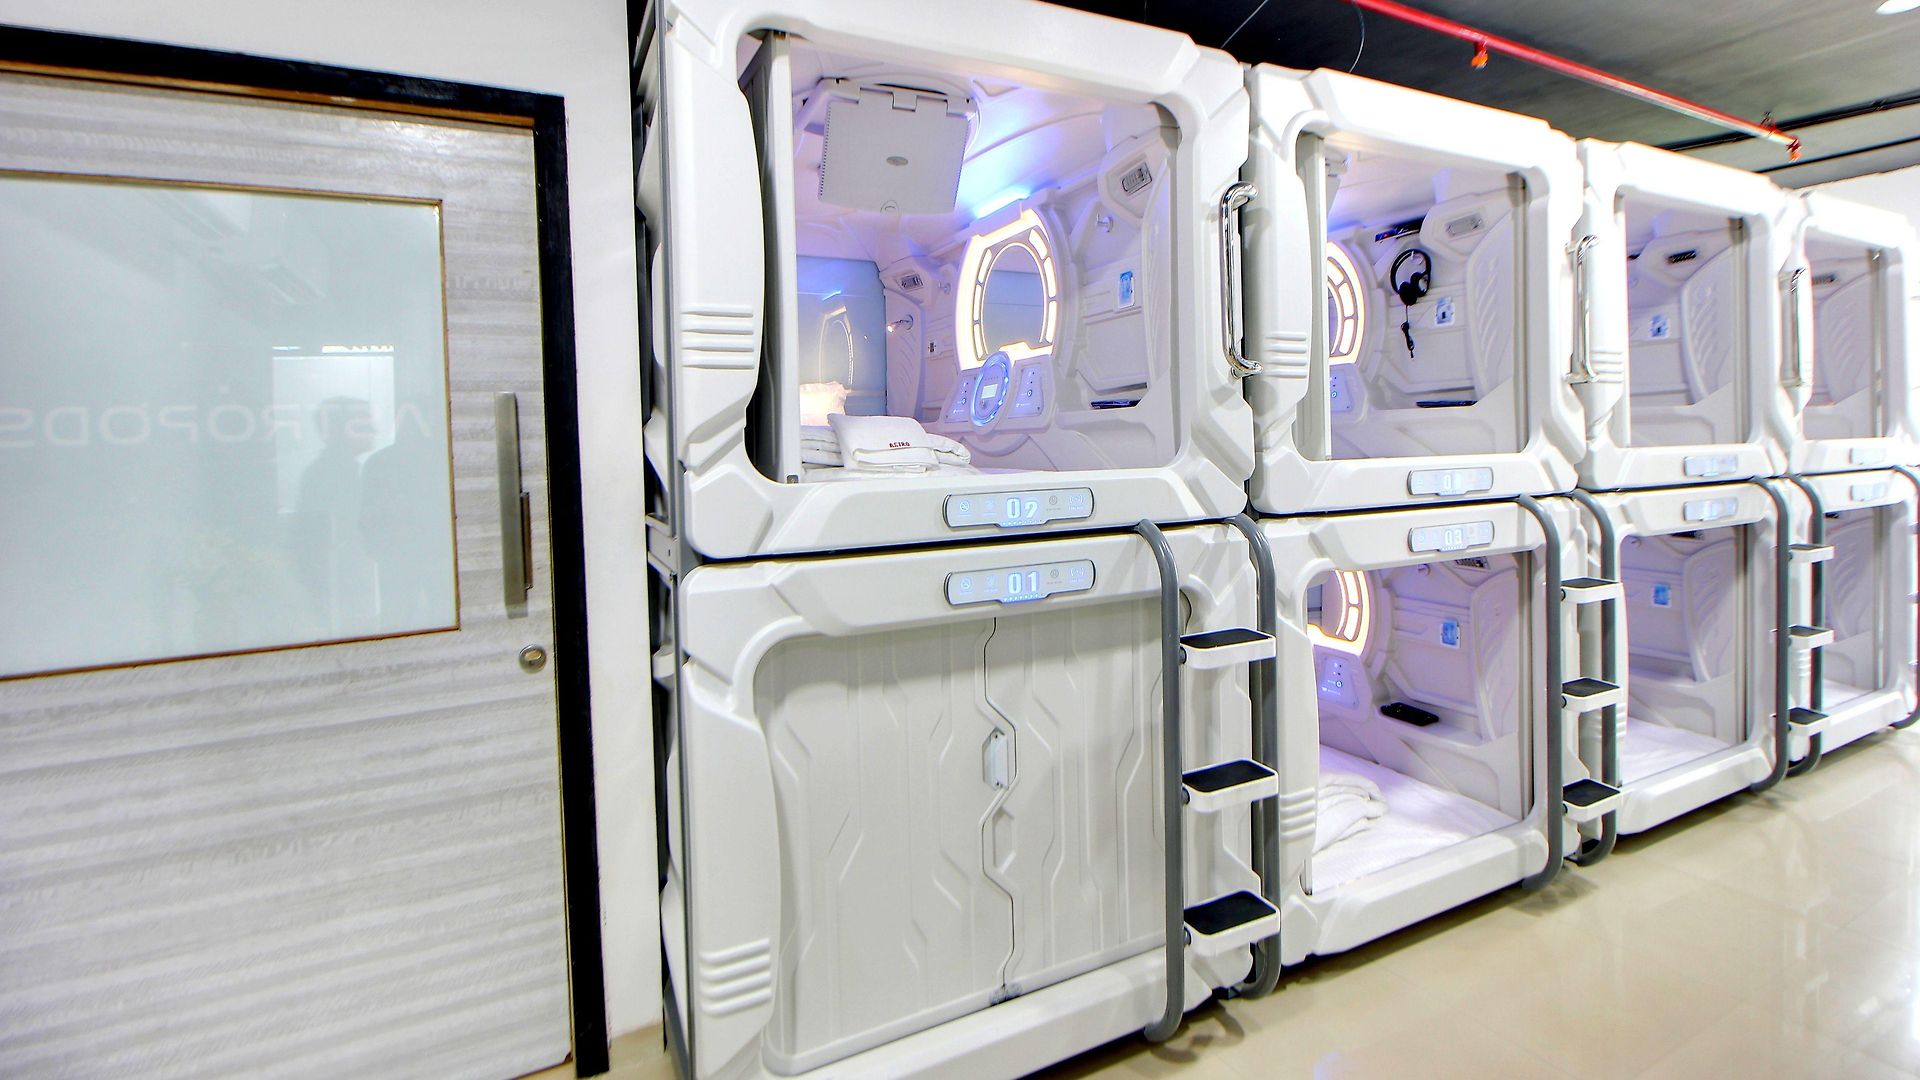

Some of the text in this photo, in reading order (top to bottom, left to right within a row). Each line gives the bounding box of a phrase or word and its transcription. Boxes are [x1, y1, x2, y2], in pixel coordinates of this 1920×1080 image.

[1006, 497, 1039, 519] 02
[1444, 529, 1463, 545] 03
[1008, 571, 1040, 594] 01
